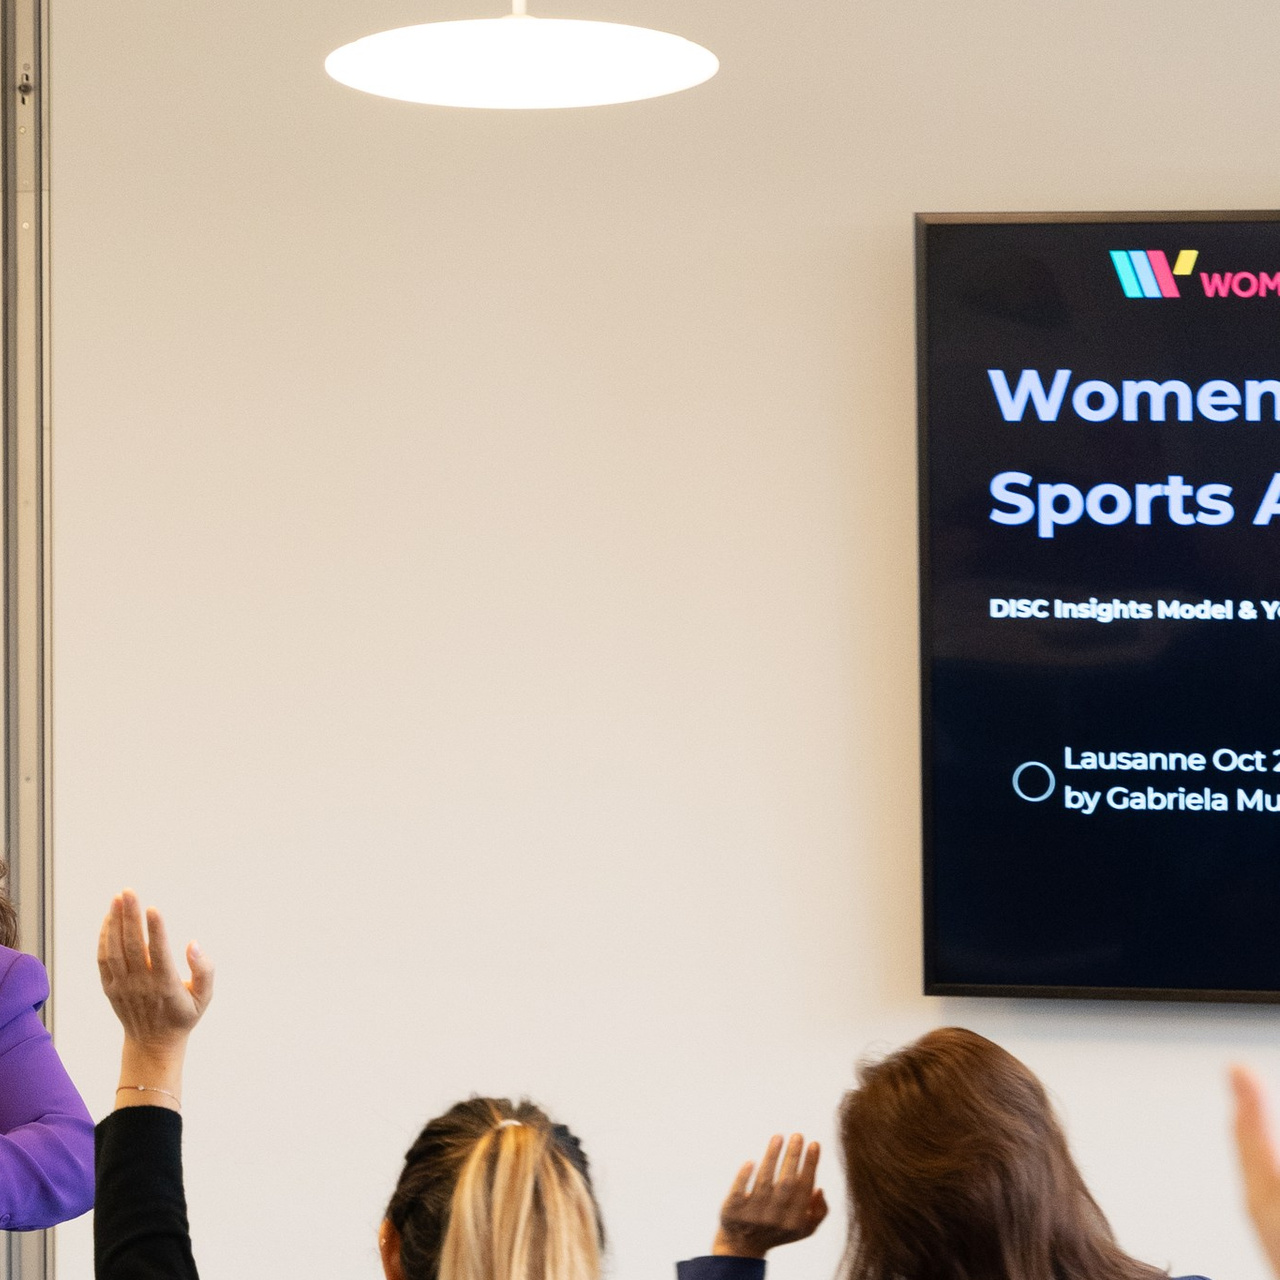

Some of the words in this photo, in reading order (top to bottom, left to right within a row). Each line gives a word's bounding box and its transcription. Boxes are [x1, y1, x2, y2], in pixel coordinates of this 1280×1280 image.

[1199, 271, 1280, 298] WOM
[987, 369, 1280, 422] Women
[989, 471, 1235, 538] Sports
[989, 598, 1049, 619] DISC
[1054, 597, 1153, 623] Insights
[1157, 599, 1233, 620] Model
[1238, 600, 1258, 620] &
[1260, 600, 1280, 620] Y
[1065, 747, 1207, 771] Lausanne
[1212, 748, 1268, 772] Oct
[1065, 785, 1102, 814] by
[1106, 787, 1229, 812] Gabriela
[1237, 788, 1280, 812] Mu
